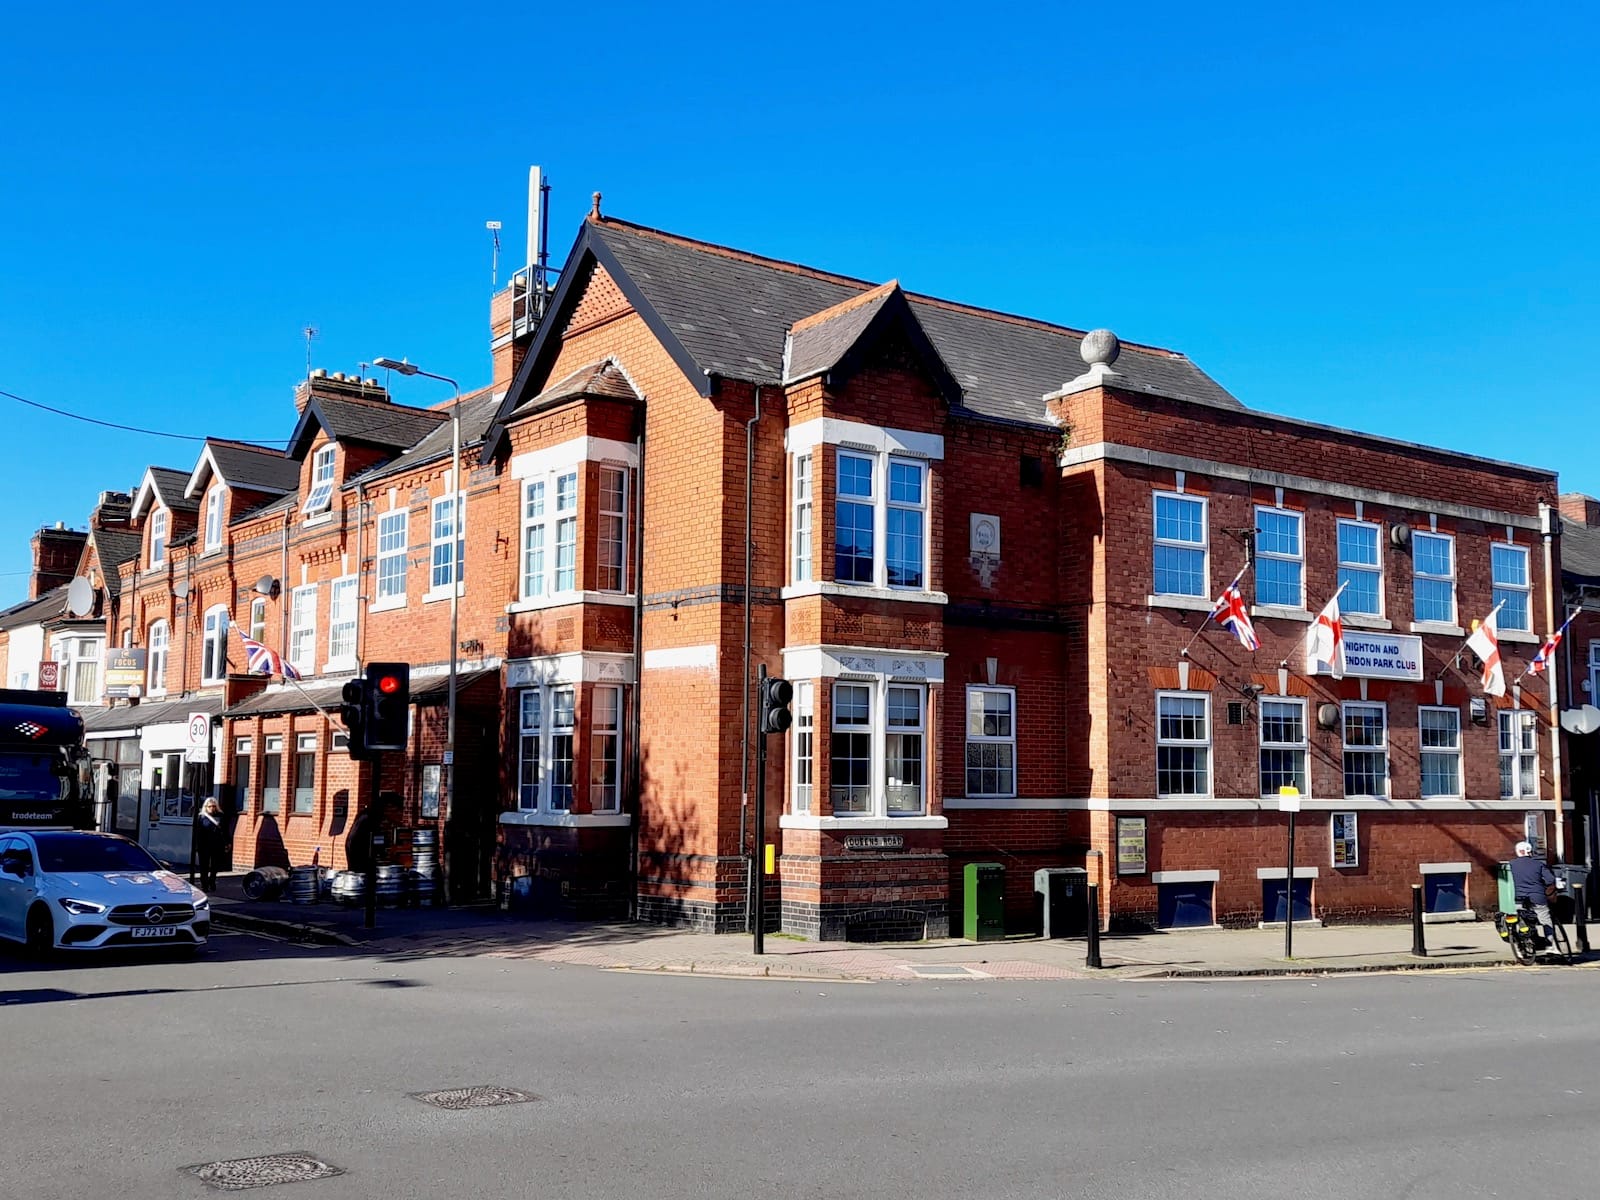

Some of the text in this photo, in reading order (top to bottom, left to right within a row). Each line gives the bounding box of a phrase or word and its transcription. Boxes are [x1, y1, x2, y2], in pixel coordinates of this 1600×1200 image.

[1344, 641, 1399, 655] NIGHTON AND
[113, 658, 137, 666] FOCUS
[1346, 656, 1416, 670] ENDON PARK CLUB
[192, 723, 205, 736] 30
[12, 811, 53, 820] tradeteam
